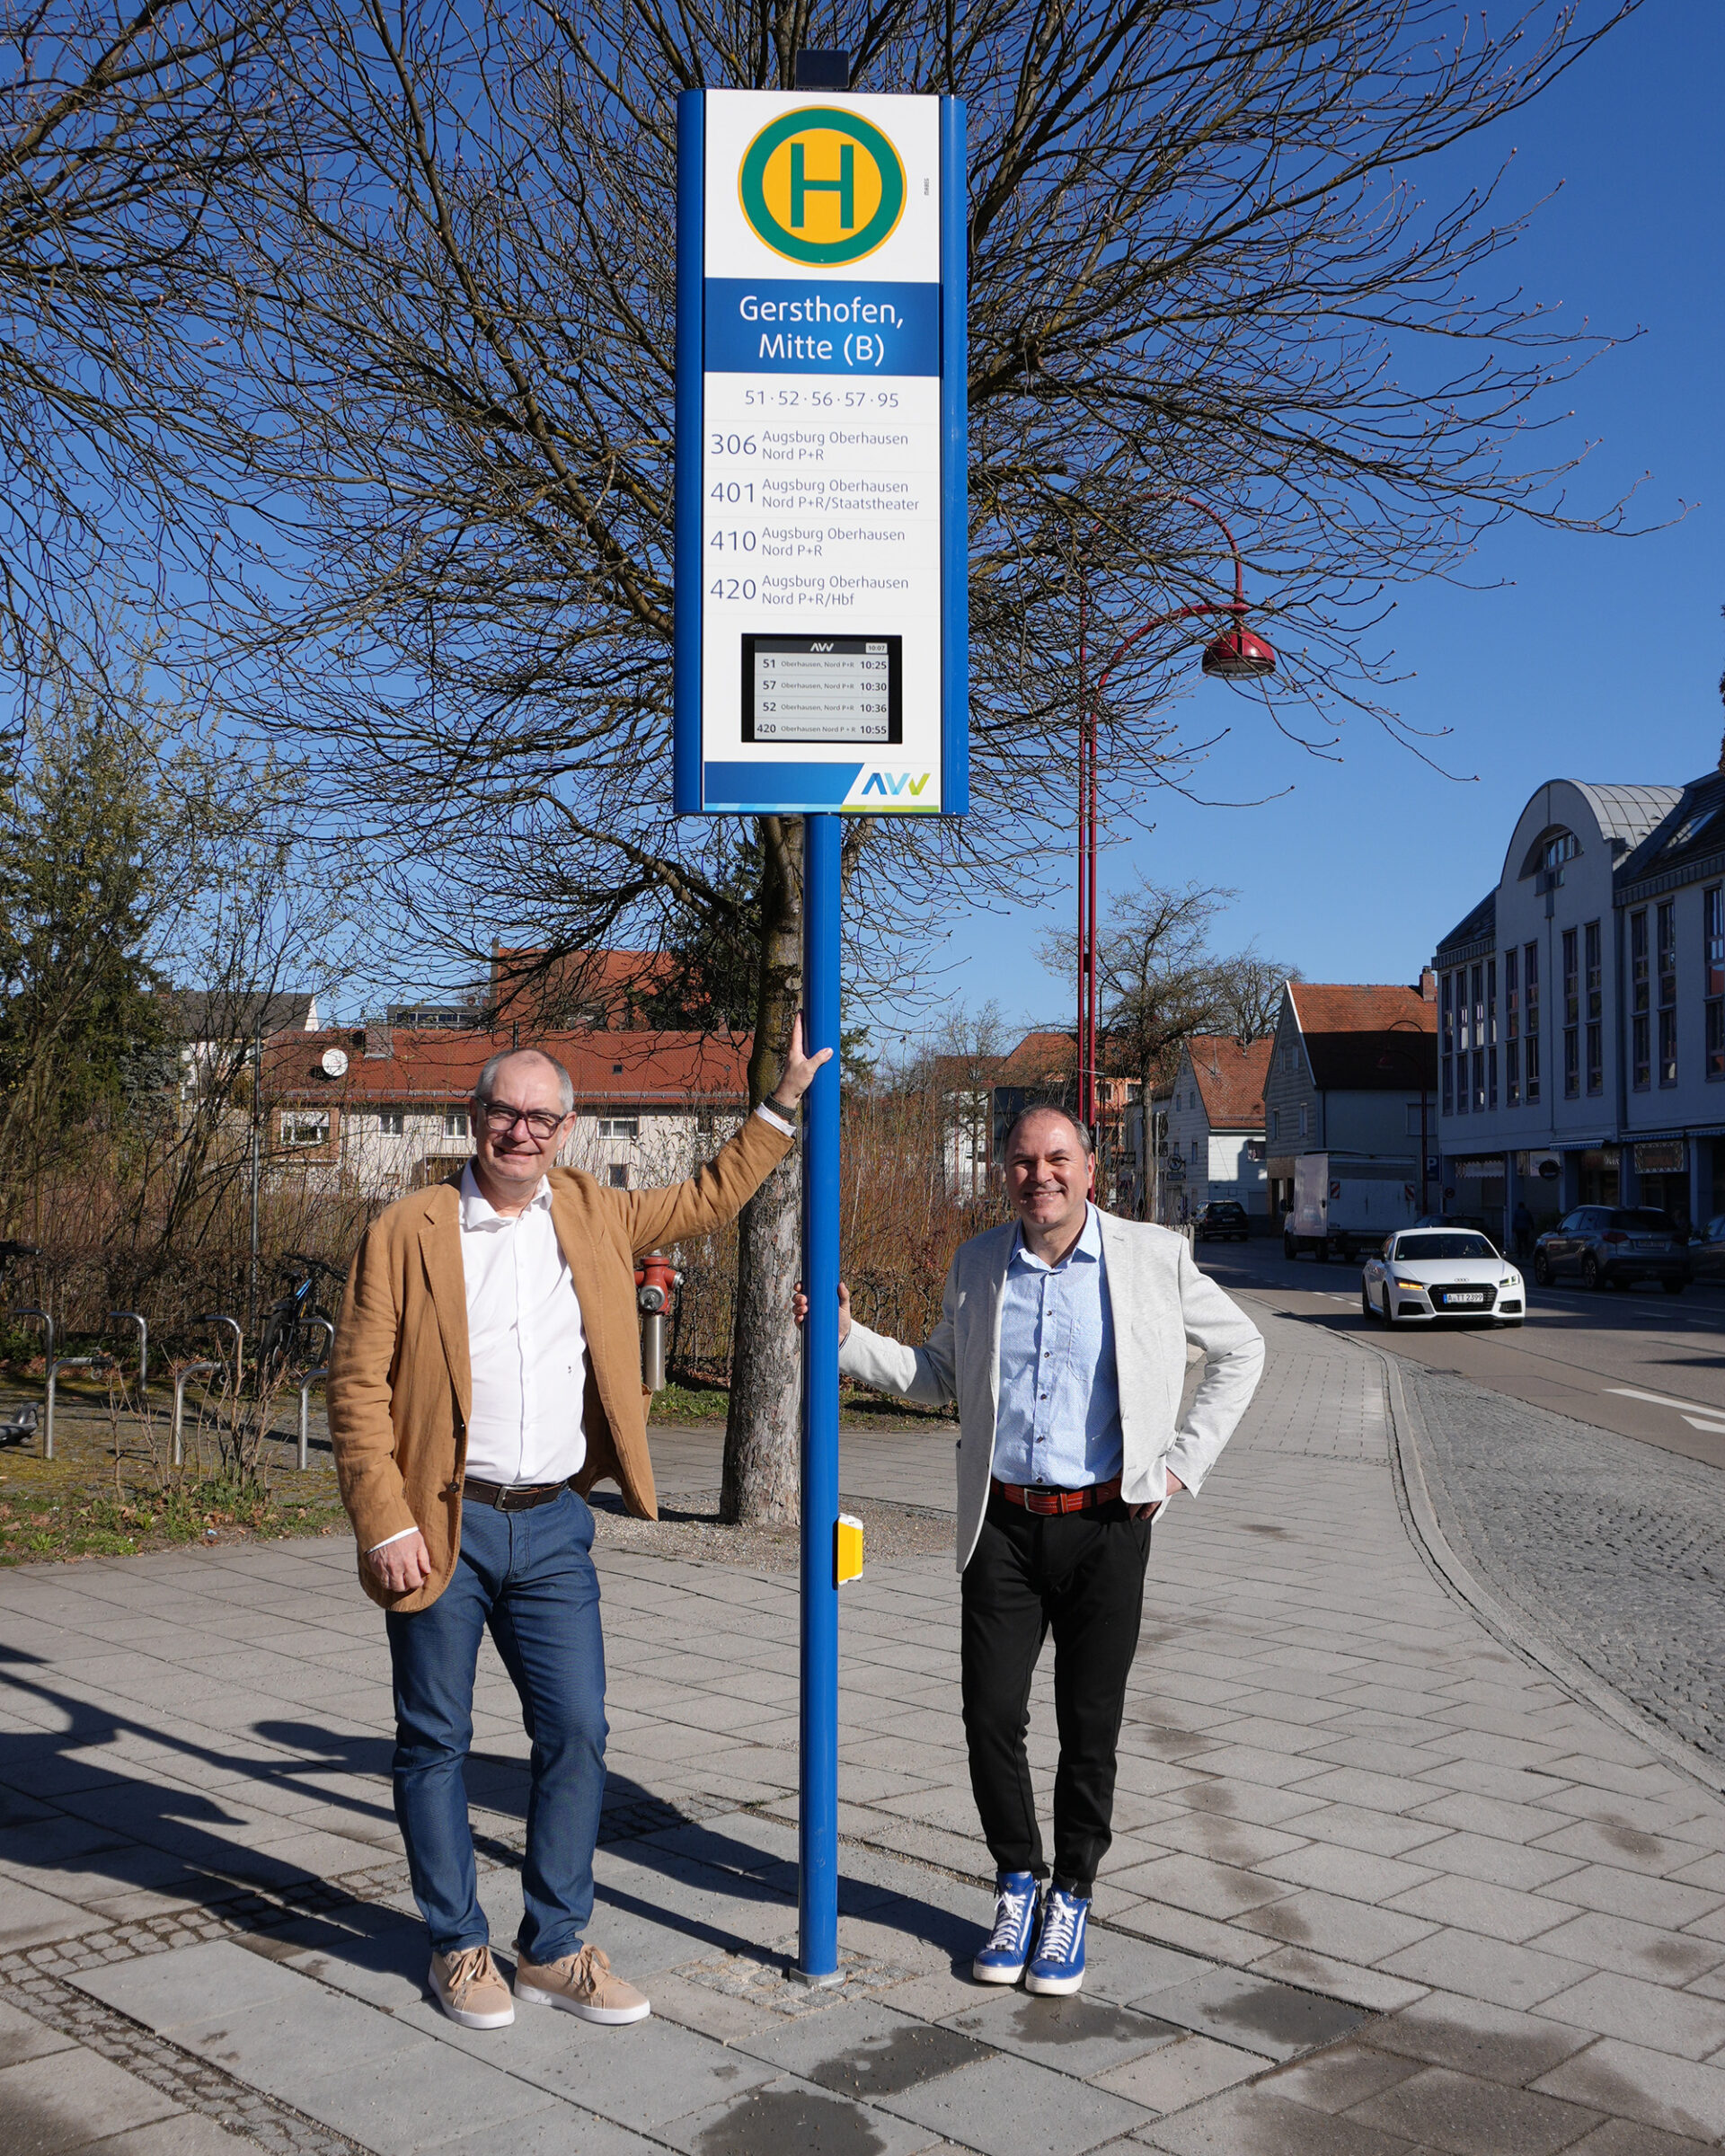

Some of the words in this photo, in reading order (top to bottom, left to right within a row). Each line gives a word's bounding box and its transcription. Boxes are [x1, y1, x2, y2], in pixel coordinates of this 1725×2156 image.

[790, 142, 854, 229] H
[739, 295, 904, 329] Gersthofen,
[759, 333, 834, 359] Mitte
[844, 333, 885, 367] (B)
[711, 434, 757, 455] 306
[762, 430, 825, 445] Augsburg
[829, 431, 909, 444] Oberhausen
[762, 448, 794, 460] Nord
[799, 449, 824, 461] P+R
[711, 482, 754, 503] 401
[762, 478, 825, 492] Augsburg
[829, 479, 909, 491] Oberhausen
[762, 496, 794, 508] Nord
[799, 497, 919, 511] P+R/Staatstheater
[710, 530, 756, 552] 410
[762, 526, 823, 541] Augsburg
[827, 527, 906, 540] Oberhausen
[762, 544, 793, 556] Nord
[797, 545, 822, 557] P+R
[710, 579, 756, 600] 420
[762, 575, 825, 589] Augsburg
[829, 576, 909, 588] Oberhausen
[762, 593, 793, 605] Nord
[798, 593, 854, 607] P+R/Hbf
[763, 658, 776, 668] 51
[860, 660, 888, 670] 10:25
[763, 680, 776, 690] 57
[860, 682, 888, 692] 10:30
[763, 702, 776, 711] 52
[860, 703, 888, 713] 10:36
[756, 723, 776, 733] 420
[860, 725, 888, 735] 10:55
[861, 773, 932, 796] AVV
[1426, 1156, 1438, 1171] P
[1456, 1294, 1465, 1302] TT
